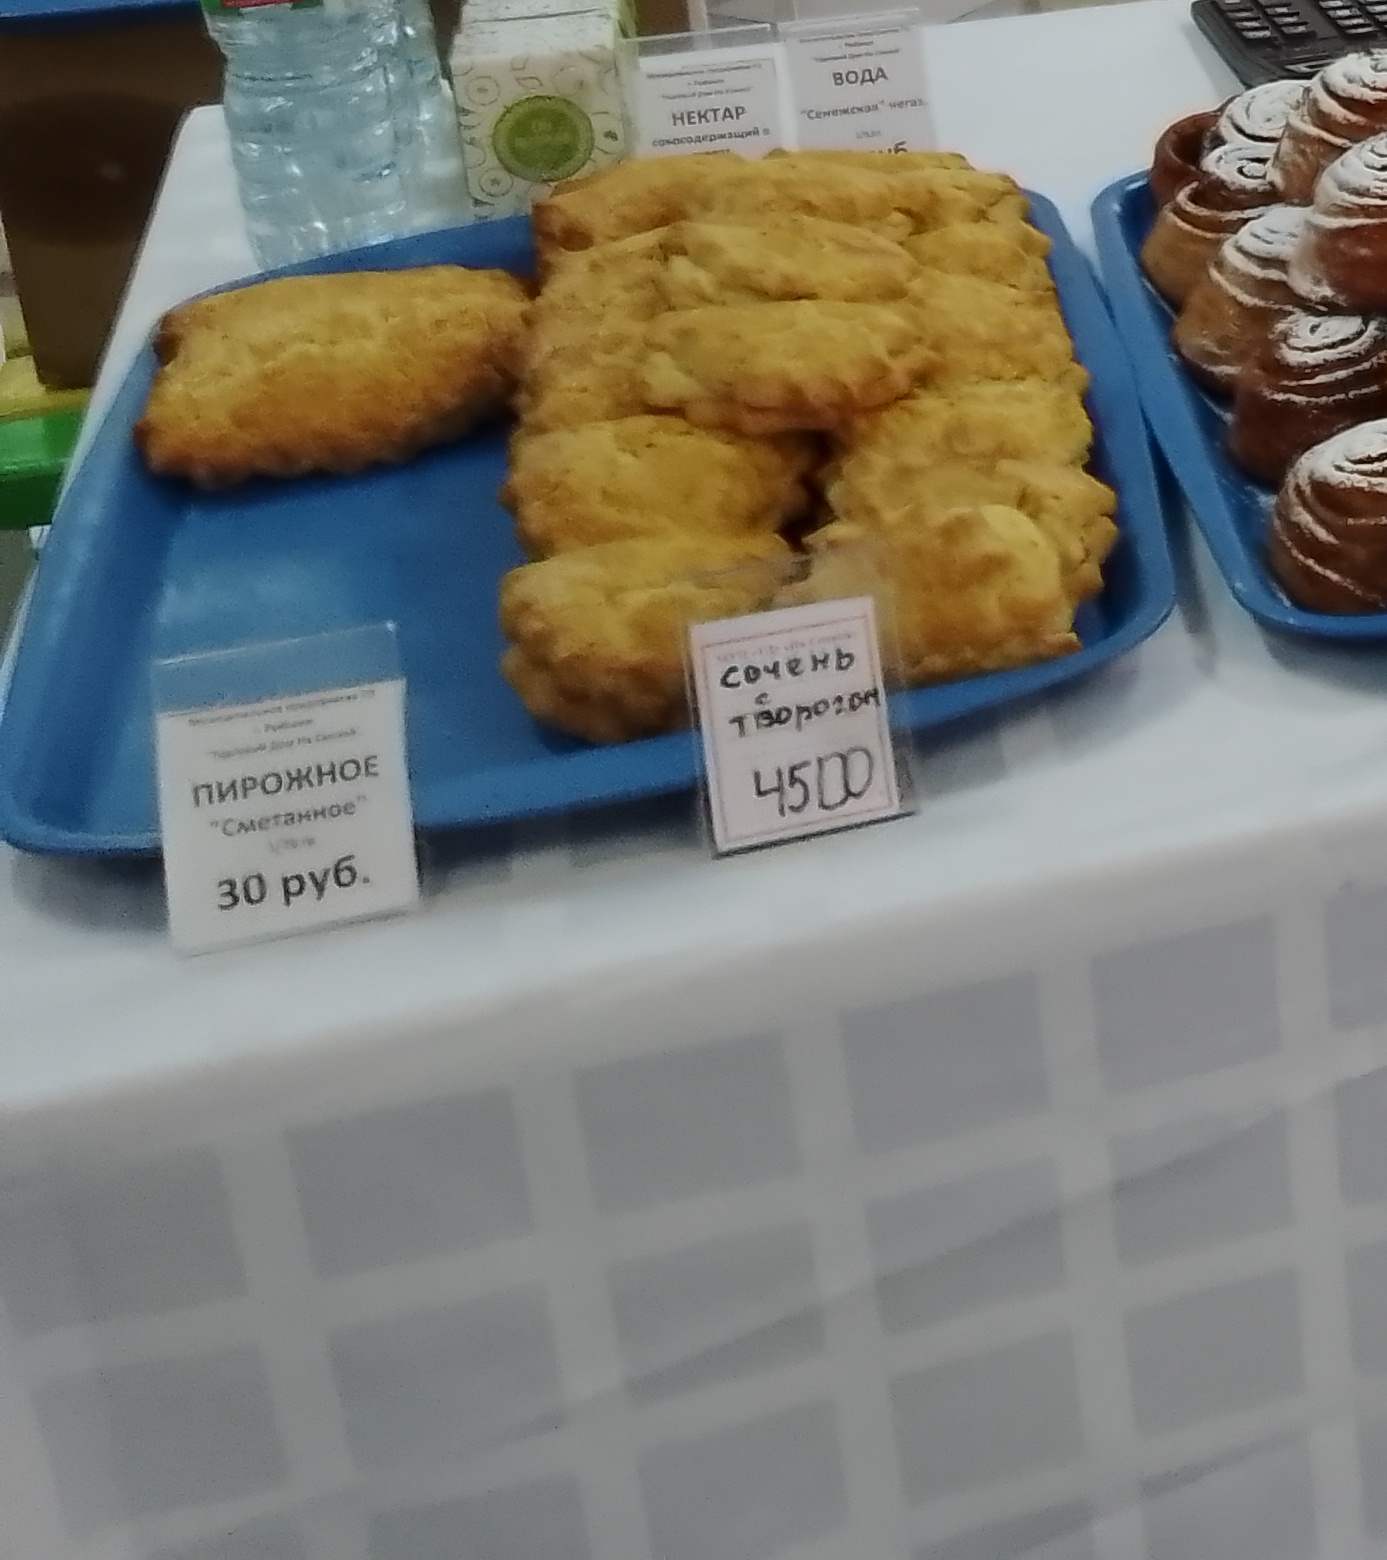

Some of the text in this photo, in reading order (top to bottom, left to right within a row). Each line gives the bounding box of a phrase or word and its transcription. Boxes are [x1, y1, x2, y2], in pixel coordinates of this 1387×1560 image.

[832, 67, 889, 87] ВОДА
[671, 105, 747, 127] НЕКТАР
[190, 753, 381, 809] ПИРОЖНОЕ
[209, 794, 368, 838] "Сметанное"
[217, 854, 371, 913] 30 руб.
